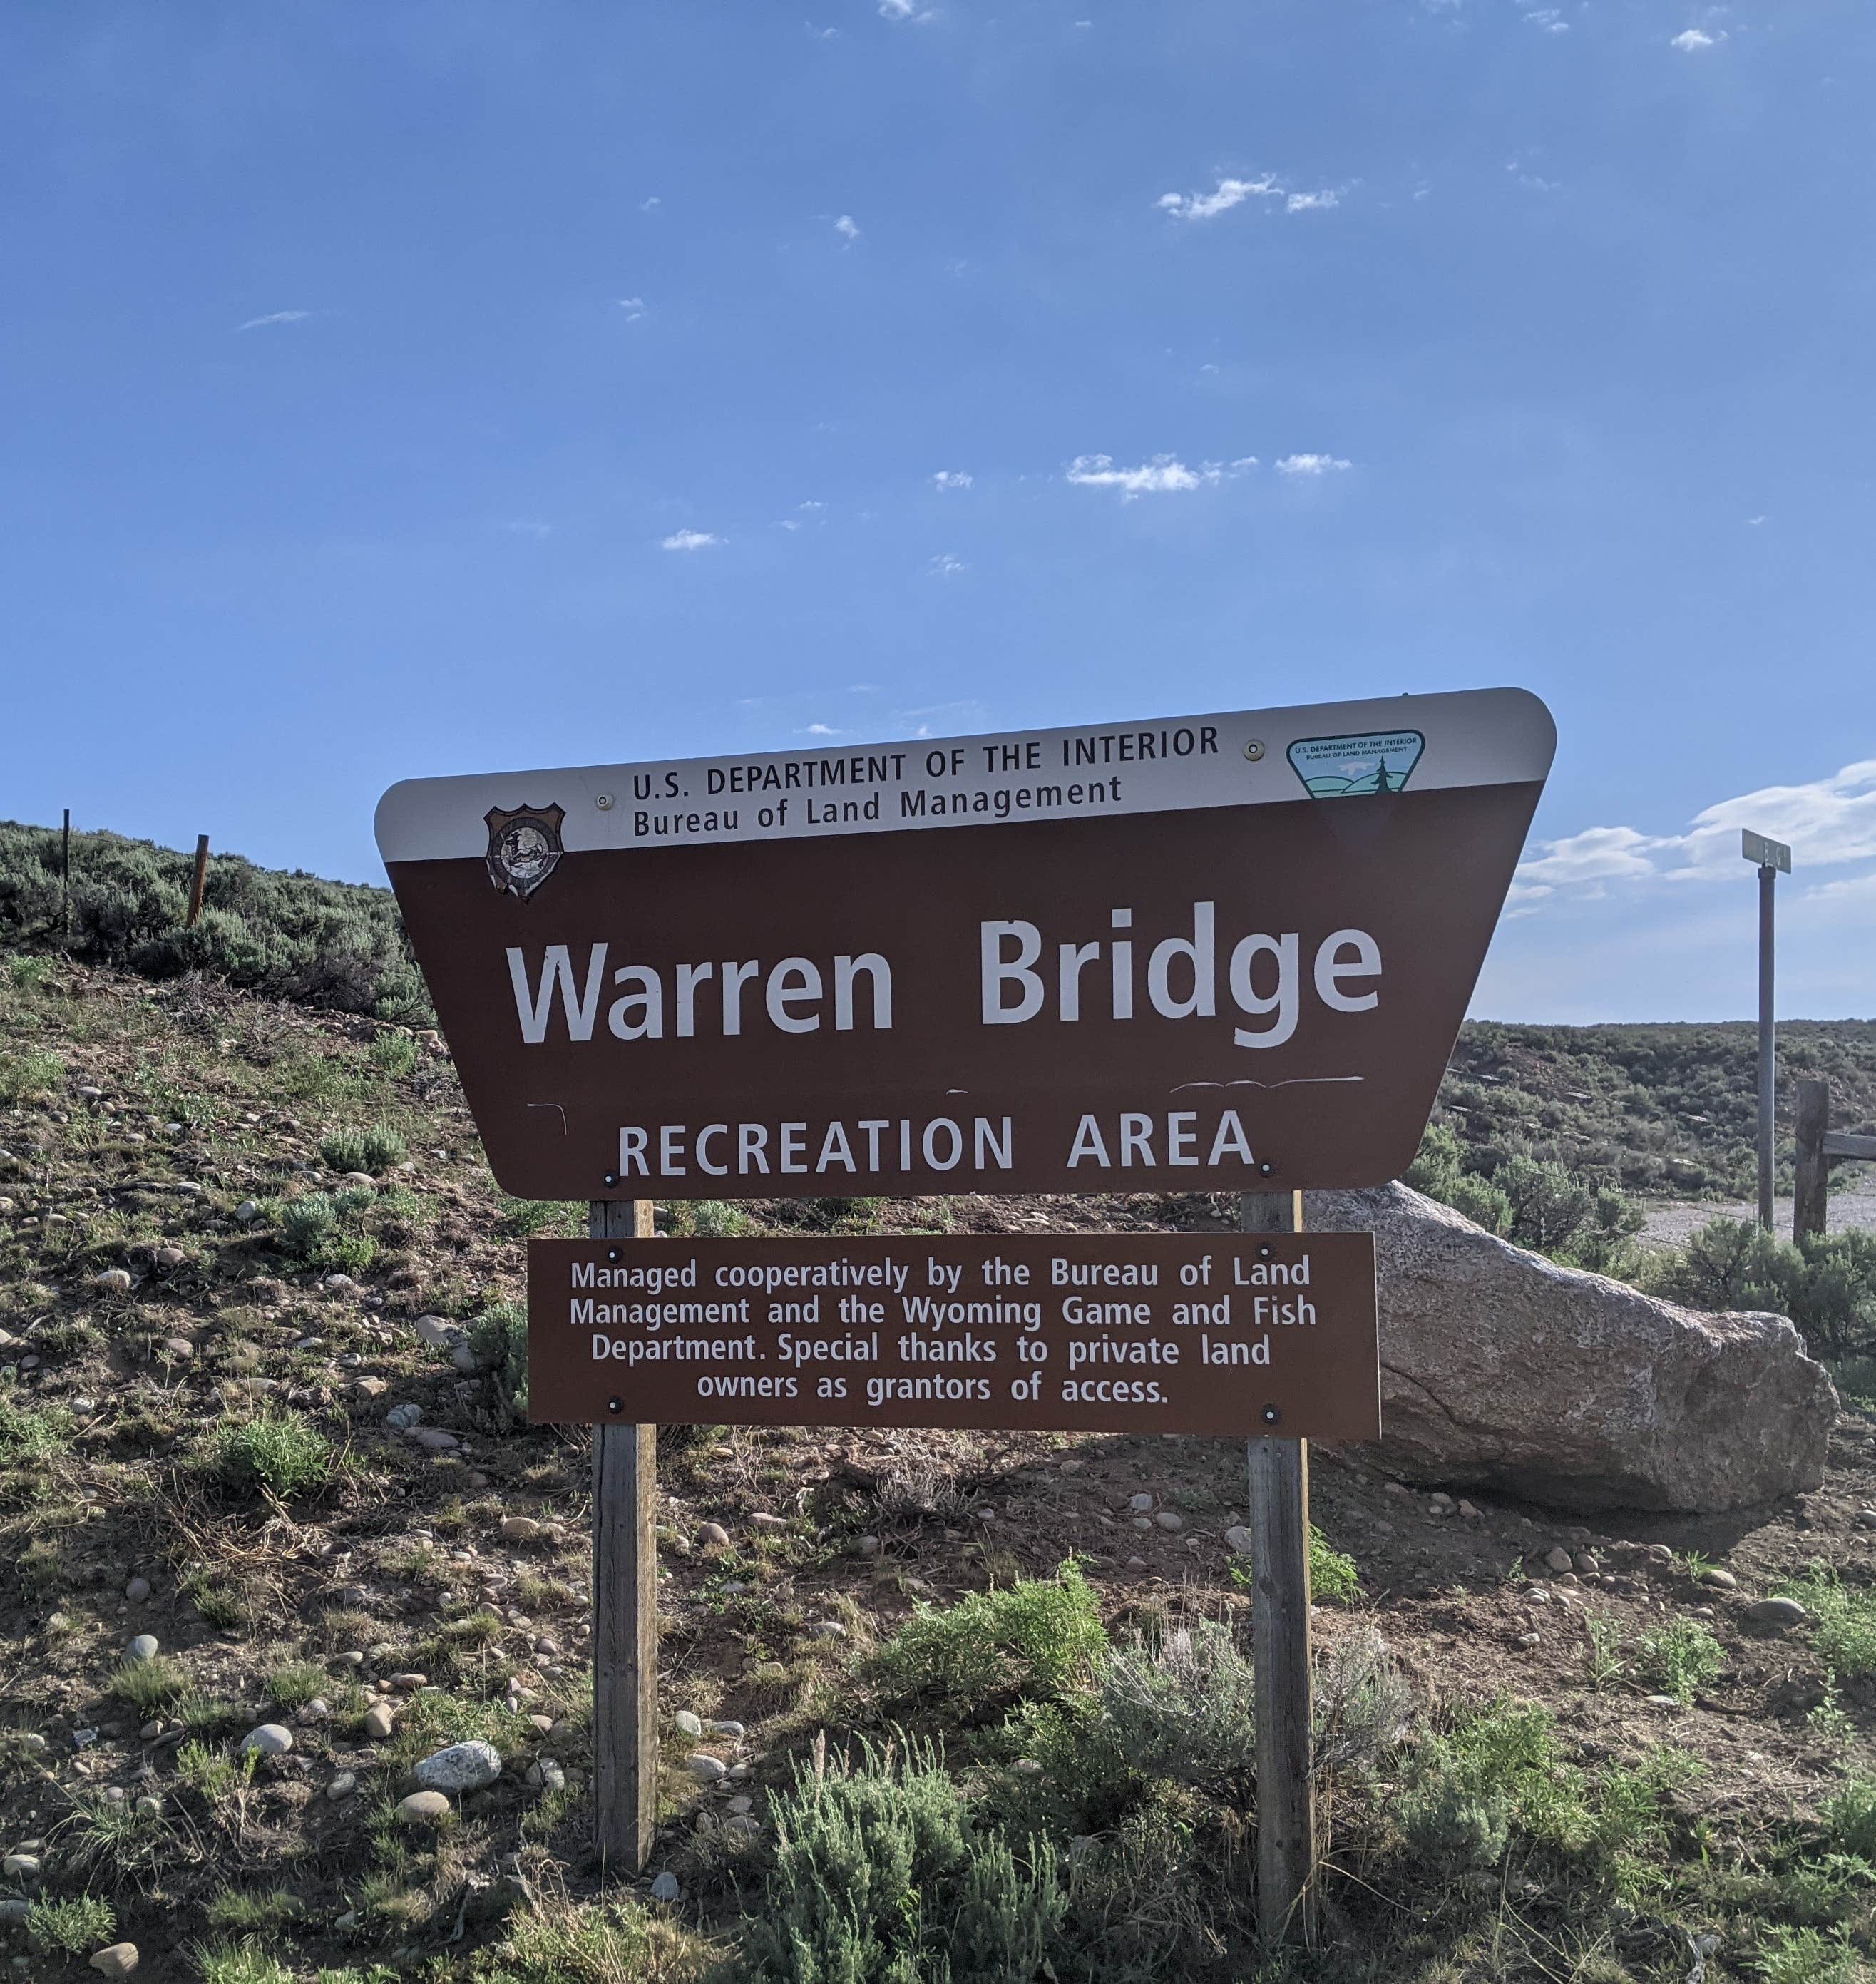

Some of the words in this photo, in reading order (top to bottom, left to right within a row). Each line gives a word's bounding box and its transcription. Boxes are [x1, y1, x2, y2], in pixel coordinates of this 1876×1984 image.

[633, 772, 689, 800] U.S.
[707, 754, 906, 795] DEPARTMENT
[926, 748, 965, 777] OF
[982, 742, 1041, 773] THE
[1063, 726, 1219, 767] INTERIOR
[1311, 743, 1356, 752] DEPARTMENT
[634, 810, 738, 837] Bureau
[757, 798, 789, 827] of
[807, 792, 879, 824] Land
[900, 775, 1122, 819] Management
[506, 942, 893, 1043] Warren
[980, 901, 1383, 1048] Bridge
[619, 1116, 1013, 1177] RECREATION
[1066, 1110, 1255, 1168] AREA
[571, 1259, 696, 1295] Managed
[715, 1257, 909, 1294] cooperatively
[928, 1257, 963, 1294] by
[981, 1256, 1030, 1285] the
[1052, 1258, 1158, 1286] Bureau
[1179, 1255, 1212, 1286] of
[1234, 1254, 1310, 1285] Land
[570, 1298, 750, 1331] Management
[767, 1294, 819, 1324] and
[838, 1294, 885, 1324] the
[901, 1294, 1040, 1332] Wyoming
[1062, 1296, 1151, 1324] Game
[1172, 1294, 1230, 1325] and
[1254, 1294, 1316, 1325] Fish
[592, 1334, 766, 1367] Department.
[778, 1331, 878, 1368] Special
[897, 1331, 997, 1361] thanks
[1016, 1336, 1048, 1362] to
[1069, 1334, 1179, 1371] private
[1201, 1334, 1270, 1365] land
[697, 1376, 798, 1398] owners
[816, 1377, 847, 1398] as
[866, 1374, 991, 1406] grantors
[1011, 1371, 1042, 1401] of
[1061, 1380, 1169, 1403] access.
